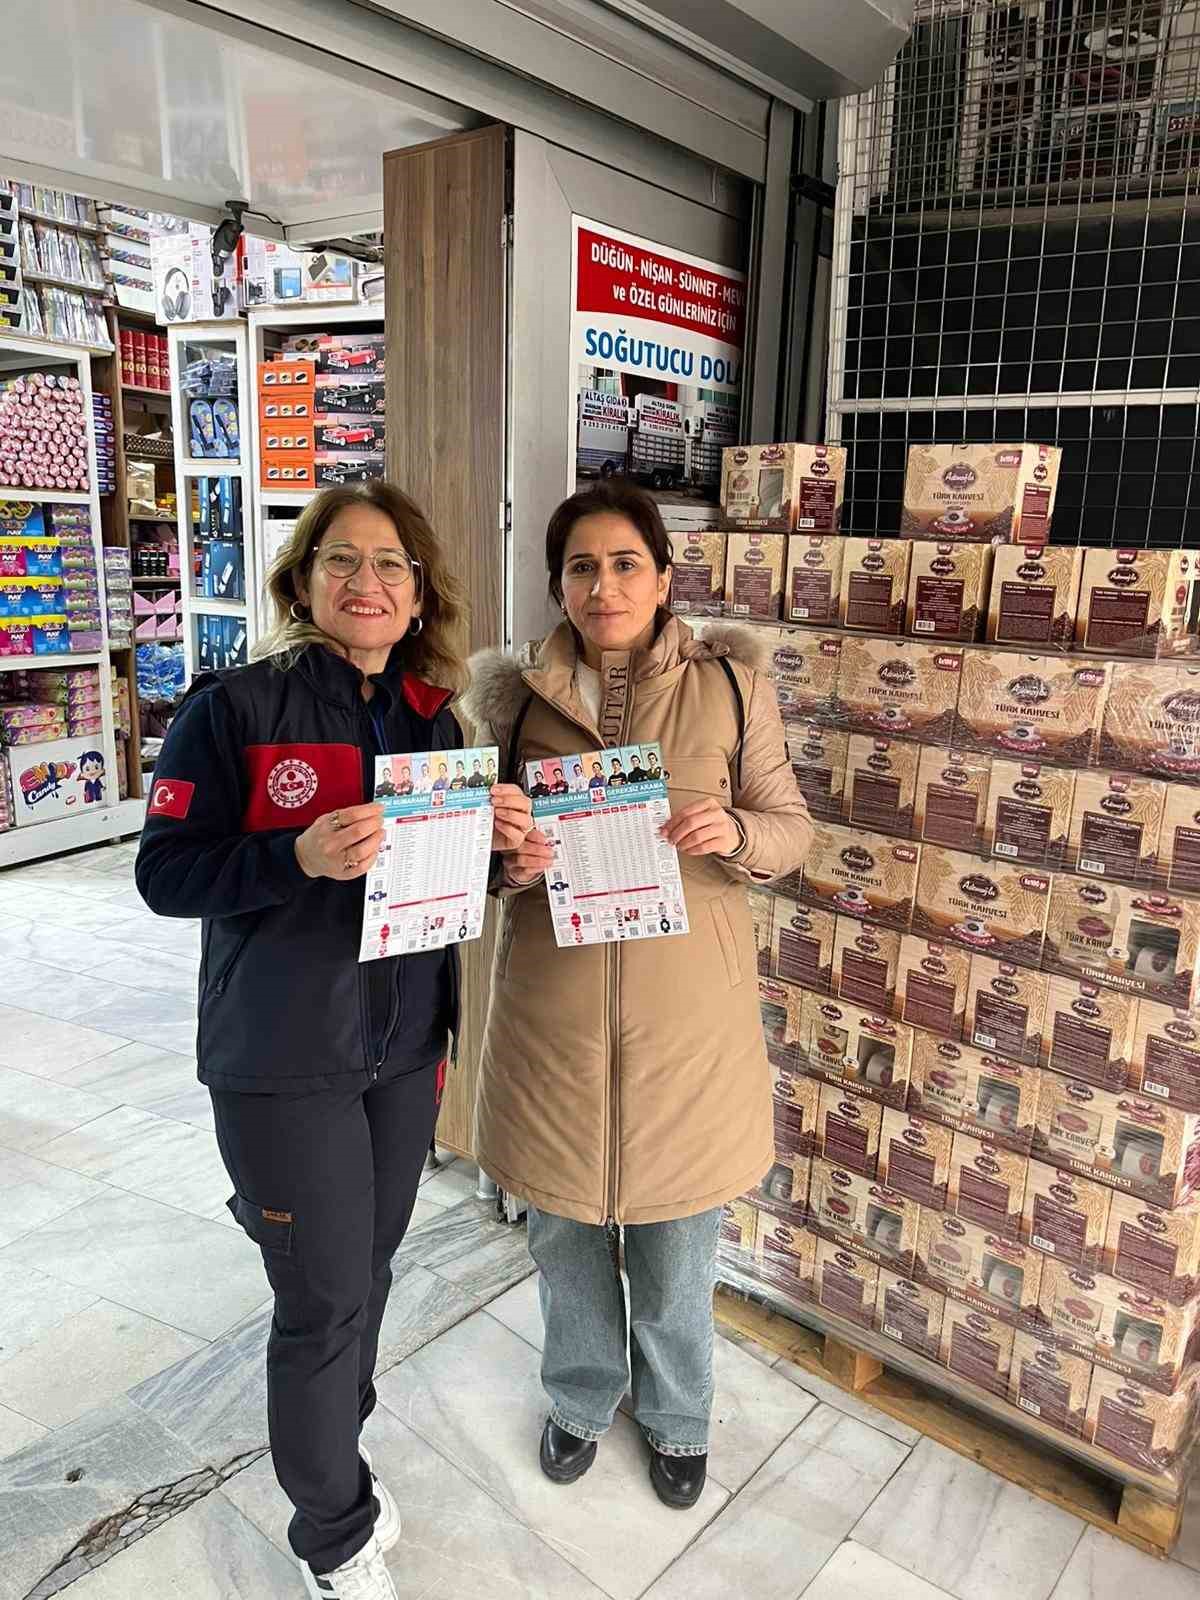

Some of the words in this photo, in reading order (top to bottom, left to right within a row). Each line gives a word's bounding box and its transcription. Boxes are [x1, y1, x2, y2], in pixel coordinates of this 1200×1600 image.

[591, 242, 634, 274] DÜĞÜN
[640, 258, 673, 286] NİŞAN
[678, 270, 718, 299] SÜNNET
[612, 284, 626, 301] ve
[629, 282, 657, 310] ÖZEL
[658, 293, 717, 326] GÜNLERİNİZ
[717, 307, 737, 333] İÇİN
[585, 328, 694, 377] SOĞUTUCU
[994, 703, 1019, 715] TÜRK
[1020, 706, 1060, 719] KAHVESİ
[28, 783, 56, 802] Candy
[592, 788, 603, 797] 112
[606, 785, 640, 795] GEREKSİZ
[640, 781, 665, 791] ARAMA
[948, 897, 968, 909] TÜRK
[970, 901, 1008, 919] KAHVESİ
